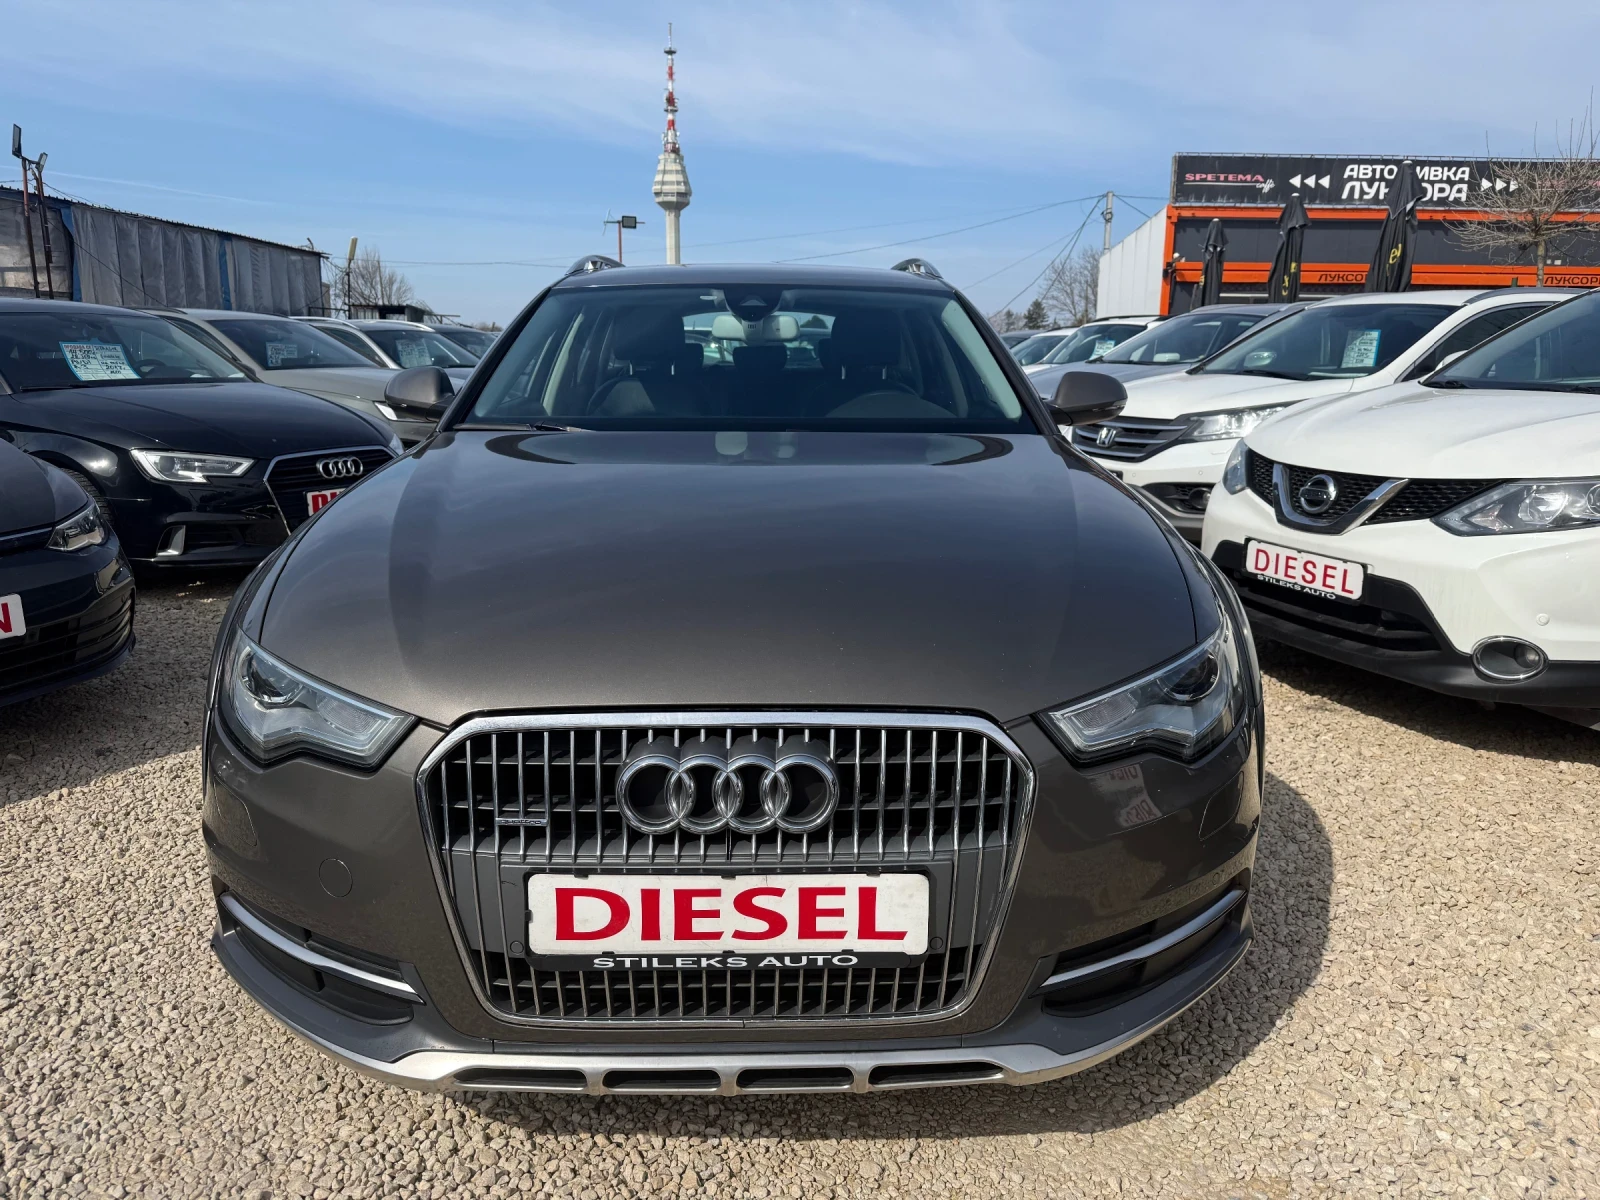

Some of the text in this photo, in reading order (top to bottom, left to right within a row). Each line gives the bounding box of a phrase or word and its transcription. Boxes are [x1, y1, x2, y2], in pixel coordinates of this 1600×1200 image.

[1185, 173, 1264, 182] SPETEMA
[1343, 164, 1470, 181] АВТОИВКА
[1341, 181, 1468, 201] ЛУКОРА
[1318, 273, 1367, 282] ЛУКСО
[1544, 276, 1600, 285] ЛУКСОР
[1254, 548, 1354, 594] DIESEL
[1257, 574, 1336, 600] STILEKS AUTO
[555, 886, 908, 941] DIESEL
[592, 954, 859, 968] STILEKS AUTO
